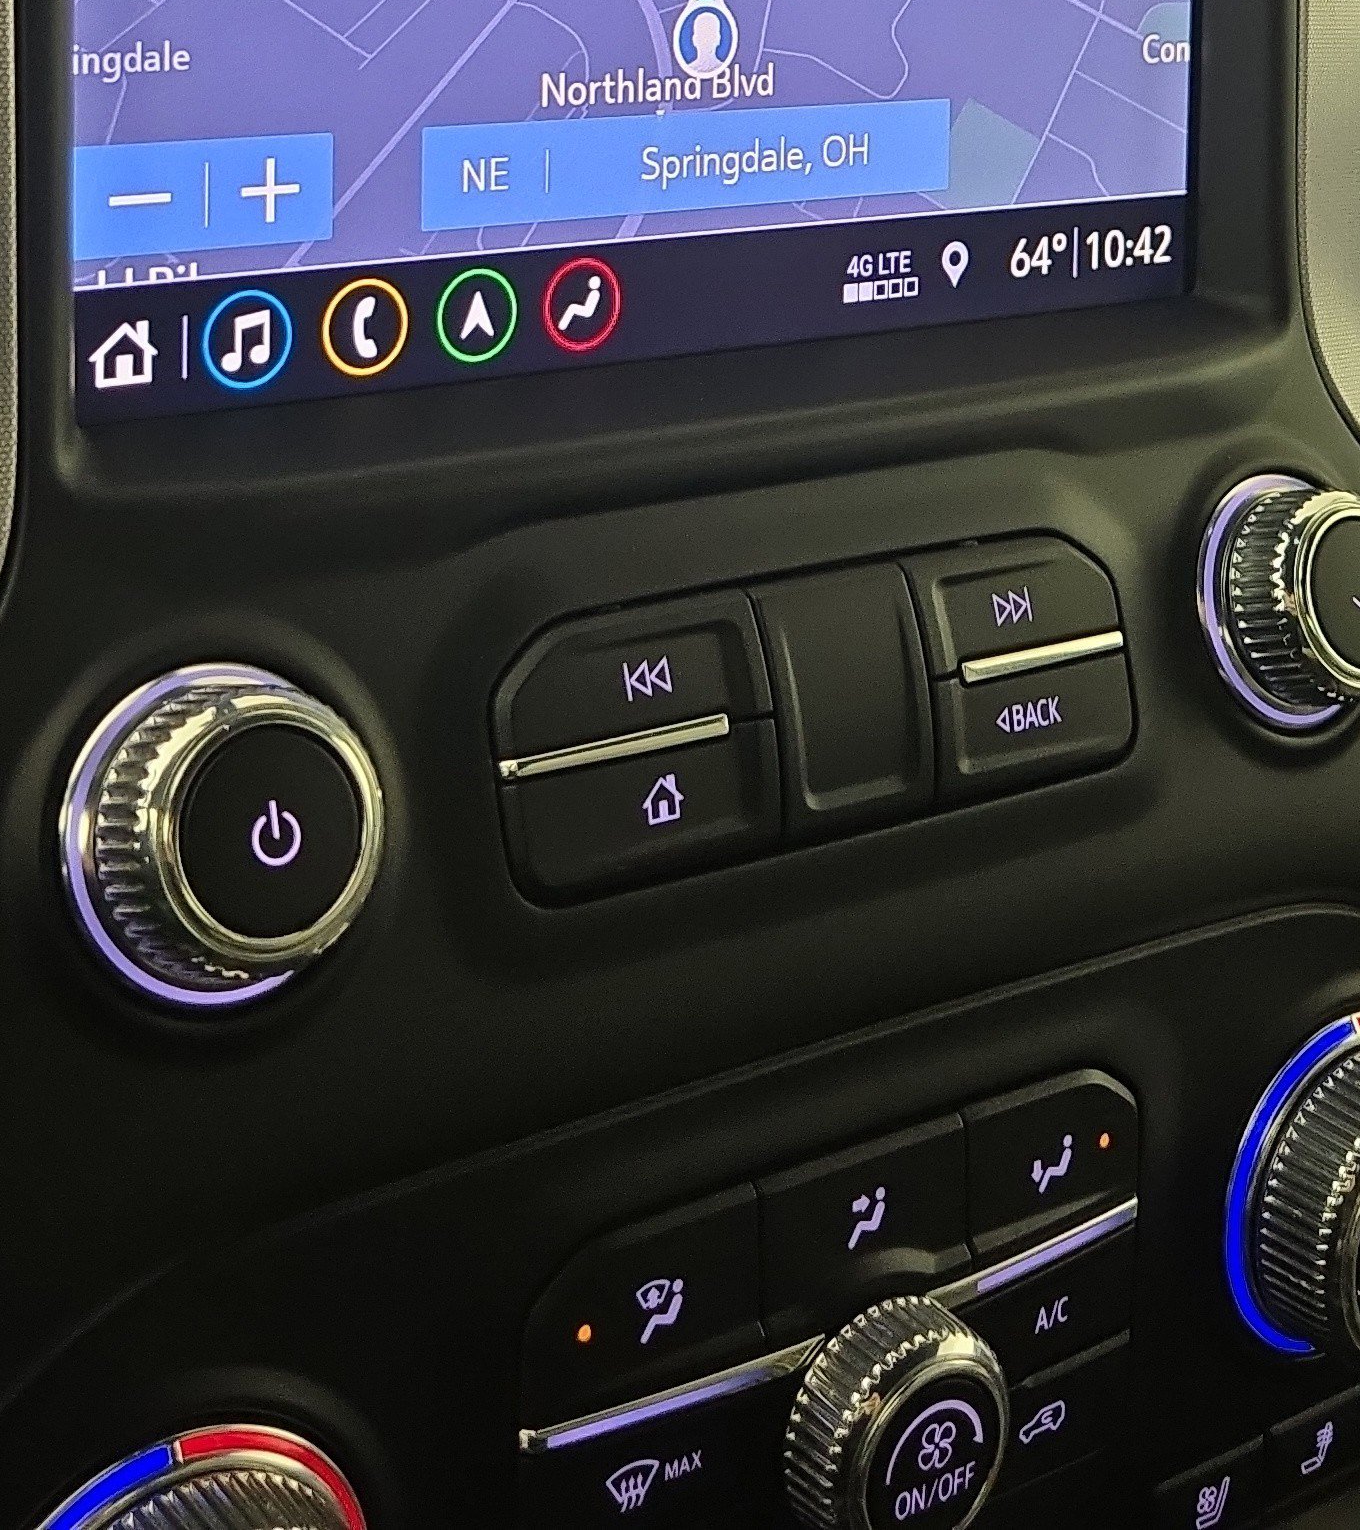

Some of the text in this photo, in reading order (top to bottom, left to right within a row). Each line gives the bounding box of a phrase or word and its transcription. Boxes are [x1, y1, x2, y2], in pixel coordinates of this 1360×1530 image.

[540, 61, 776, 109] Northland Blvd
[461, 156, 510, 193] NE
[640, 131, 870, 191] Springdale, OH
[846, 250, 912, 279] 4G LTE
[1009, 231, 1068, 279] 64°
[1085, 223, 1173, 271] 10:42
[1011, 695, 1063, 733] BACK
[1034, 1296, 1070, 1335] A/C
[663, 1449, 703, 1484] MAX
[893, 1460, 977, 1522] ON/OFF
